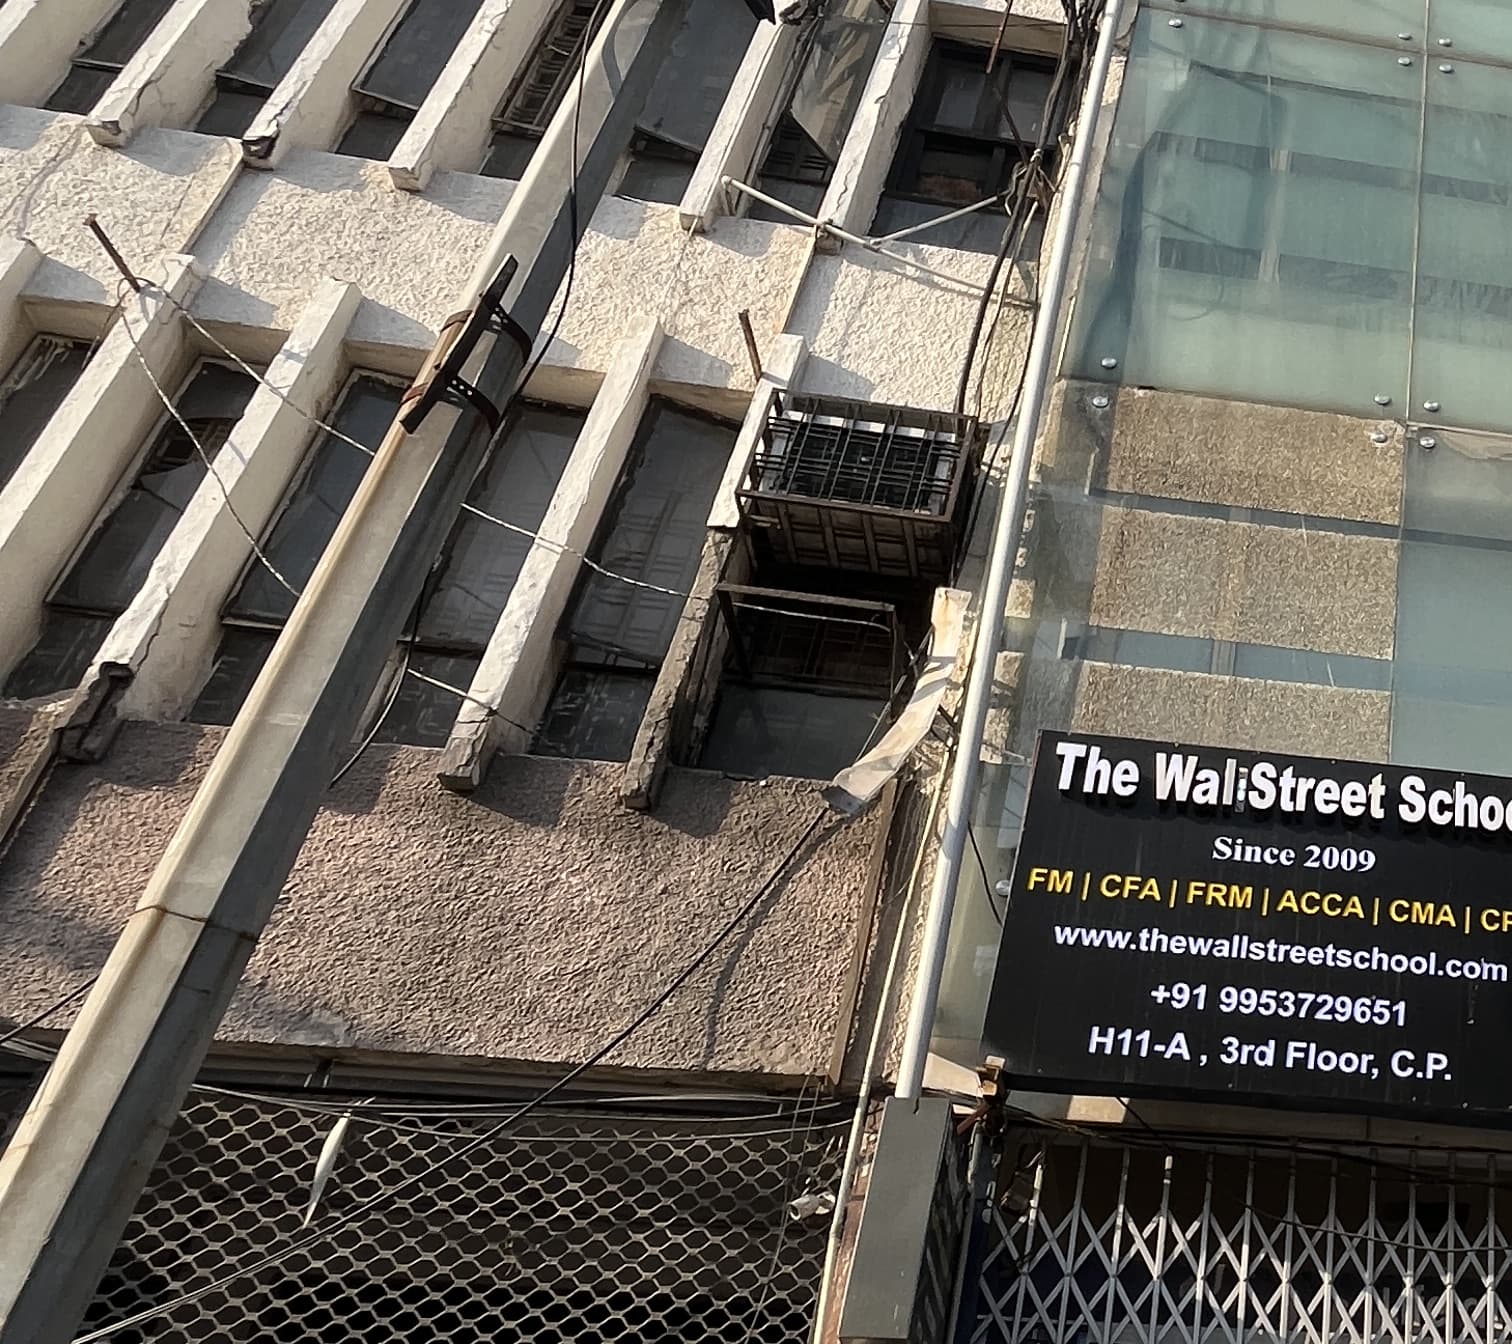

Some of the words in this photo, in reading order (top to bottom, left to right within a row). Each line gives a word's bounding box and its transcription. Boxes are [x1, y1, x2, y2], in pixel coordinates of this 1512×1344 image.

[1056, 743, 1138, 796] The
[1212, 836, 1295, 866] Since
[1304, 845, 1376, 873] 2009
[1028, 867, 1073, 894] FM
[1100, 874, 1160, 901] CFA
[1187, 881, 1252, 909] FRM
[1276, 891, 1364, 919] ACCA
[1389, 900, 1456, 927] CMA
[1054, 925, 1508, 982] www.thewallstreetschool.com
[1151, 984, 1207, 1011] +91
[1219, 989, 1407, 1027] 9953729651
[1088, 1026, 1190, 1061] H11-A
[1220, 1036, 1274, 1067] 3rd
[1286, 1043, 1378, 1077] Floor,
[1390, 1051, 1453, 1081] C.P.
